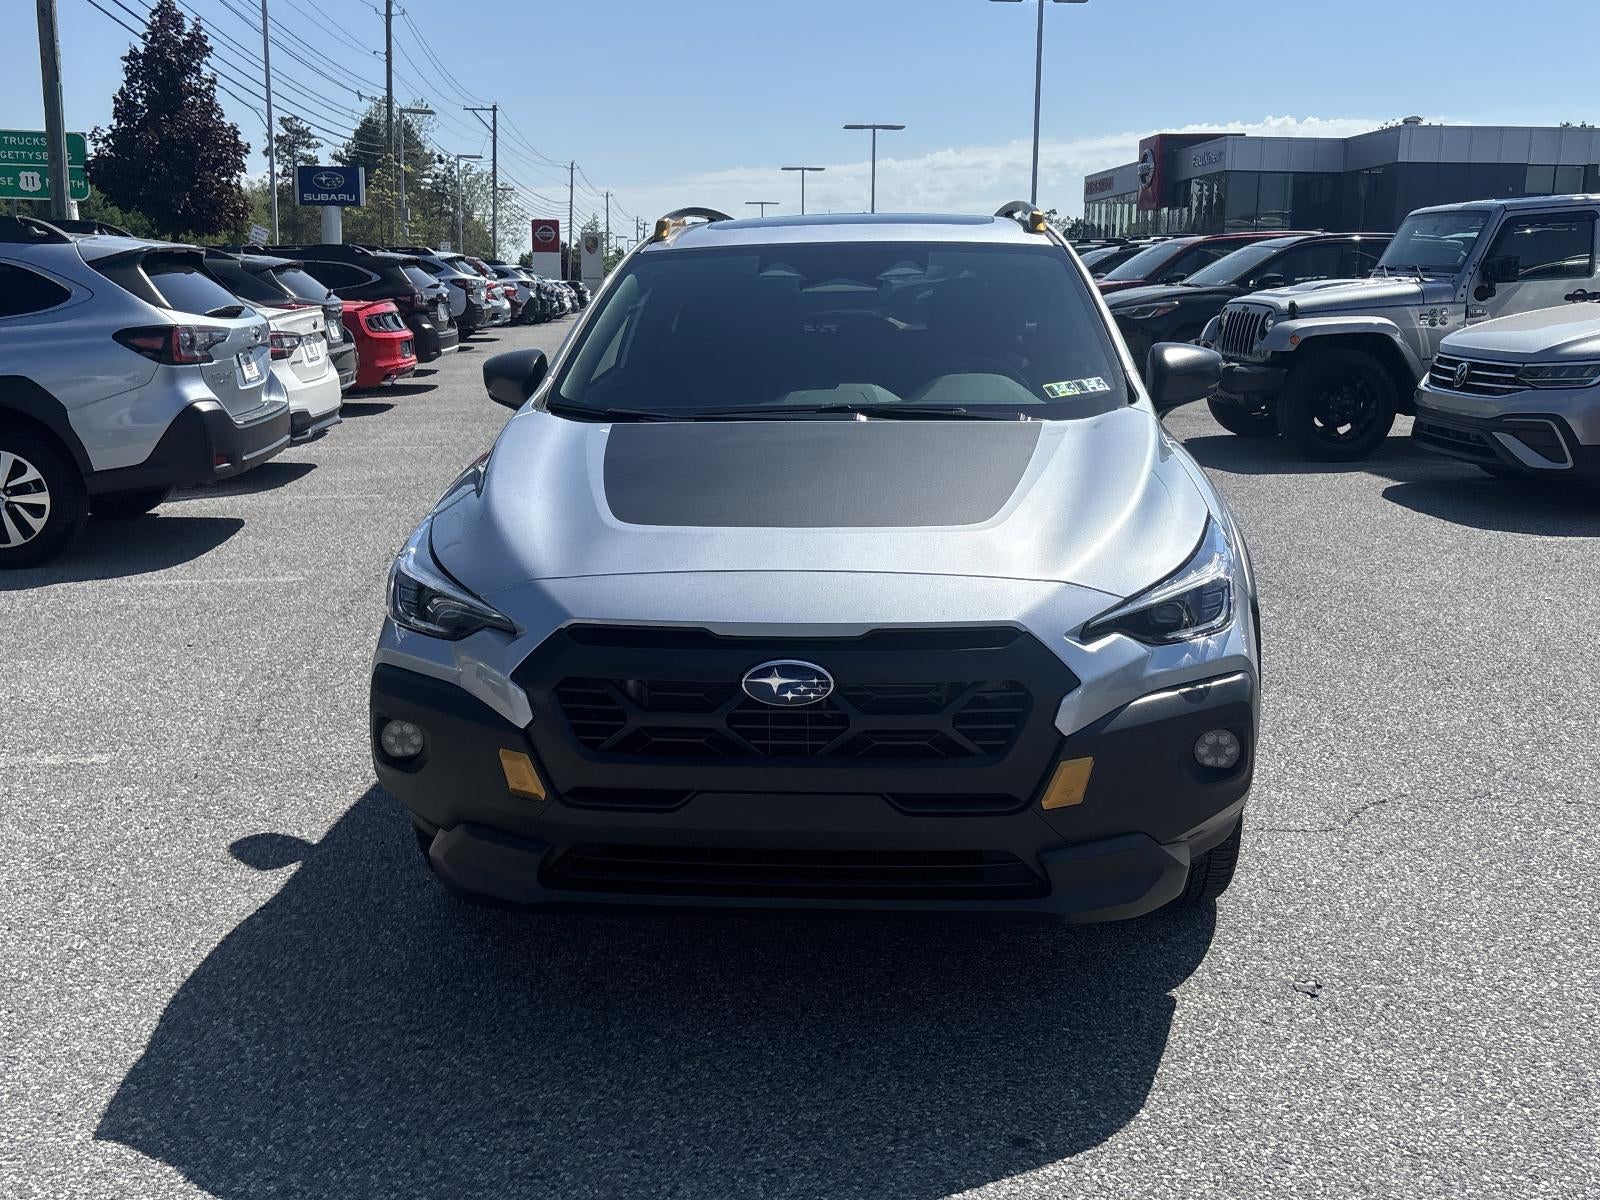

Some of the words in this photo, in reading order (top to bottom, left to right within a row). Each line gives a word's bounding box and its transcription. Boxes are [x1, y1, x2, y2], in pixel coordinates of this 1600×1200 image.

[3, 136, 47, 146] TRUCKS
[0, 150, 72, 161] GETTYSBG
[25, 175, 35, 188] 11
[303, 193, 356, 202] SUBARU
